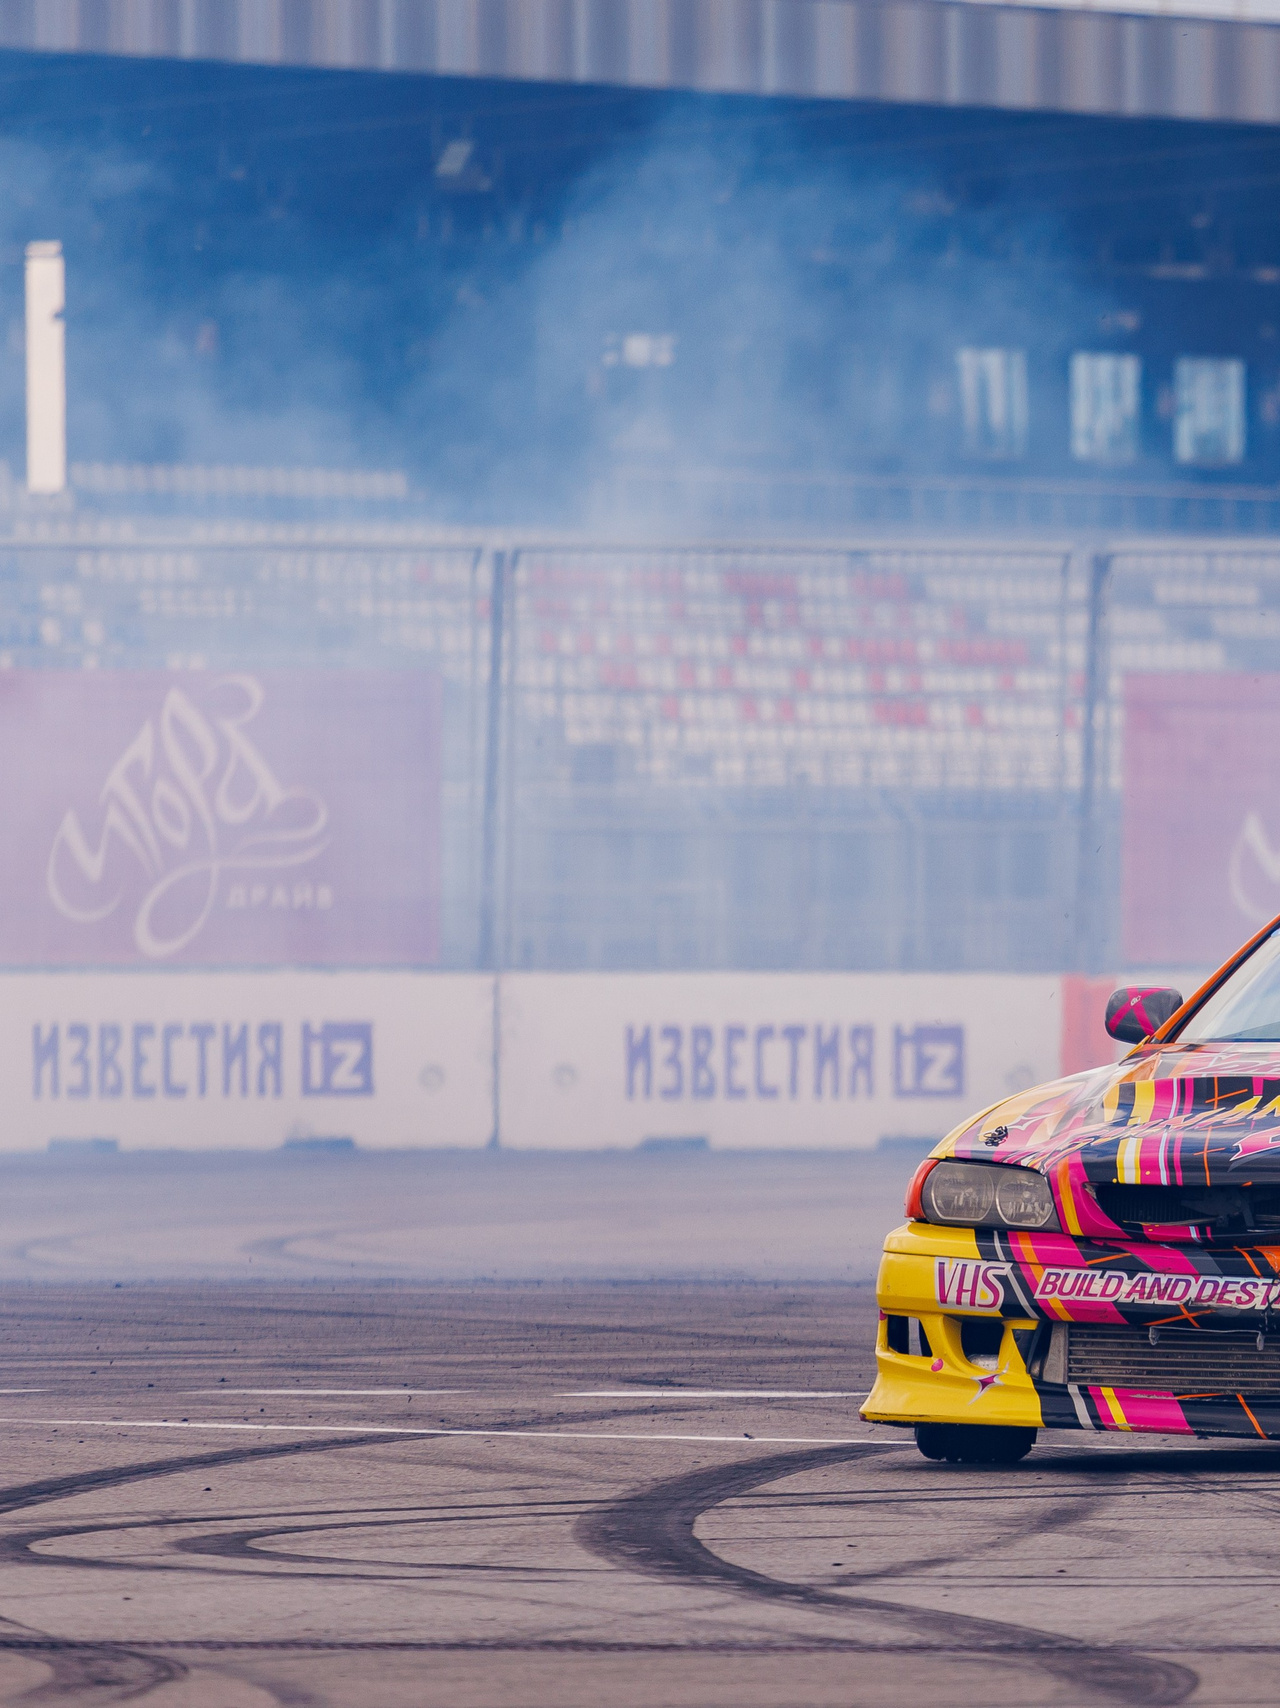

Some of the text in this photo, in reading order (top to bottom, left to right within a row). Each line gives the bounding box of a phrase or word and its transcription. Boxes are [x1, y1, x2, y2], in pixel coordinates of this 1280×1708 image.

[32, 1022, 284, 1099] ИЗВЕСТИЯ
[625, 1024, 874, 1100] ИЗВЕСТИЯ
[936, 1260, 1008, 1309] VHS
[1039, 1271, 1118, 1300] BUILD
[1123, 1273, 1193, 1305] AND
